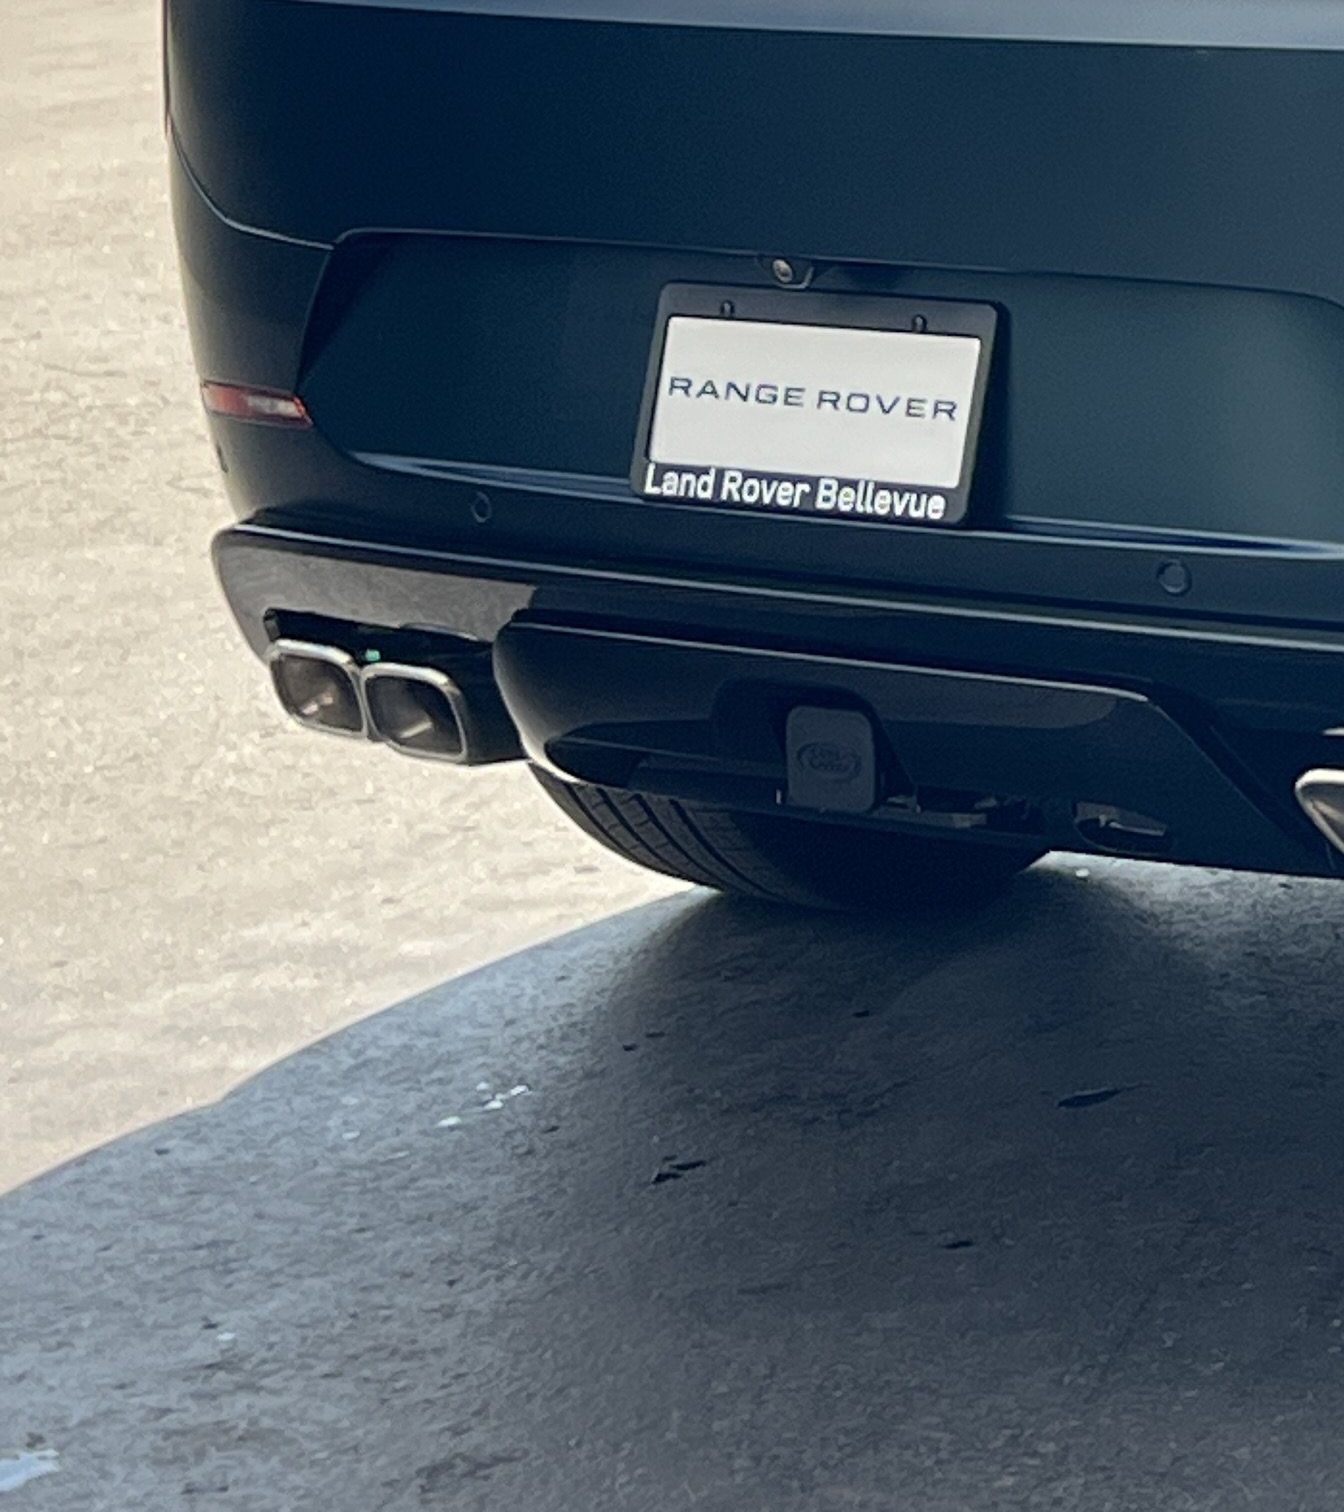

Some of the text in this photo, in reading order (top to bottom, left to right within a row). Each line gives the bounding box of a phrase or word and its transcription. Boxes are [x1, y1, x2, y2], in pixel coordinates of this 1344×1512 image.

[668, 376, 959, 422] RANGE ROVER
[644, 462, 947, 520] Land Rover Bellevue
